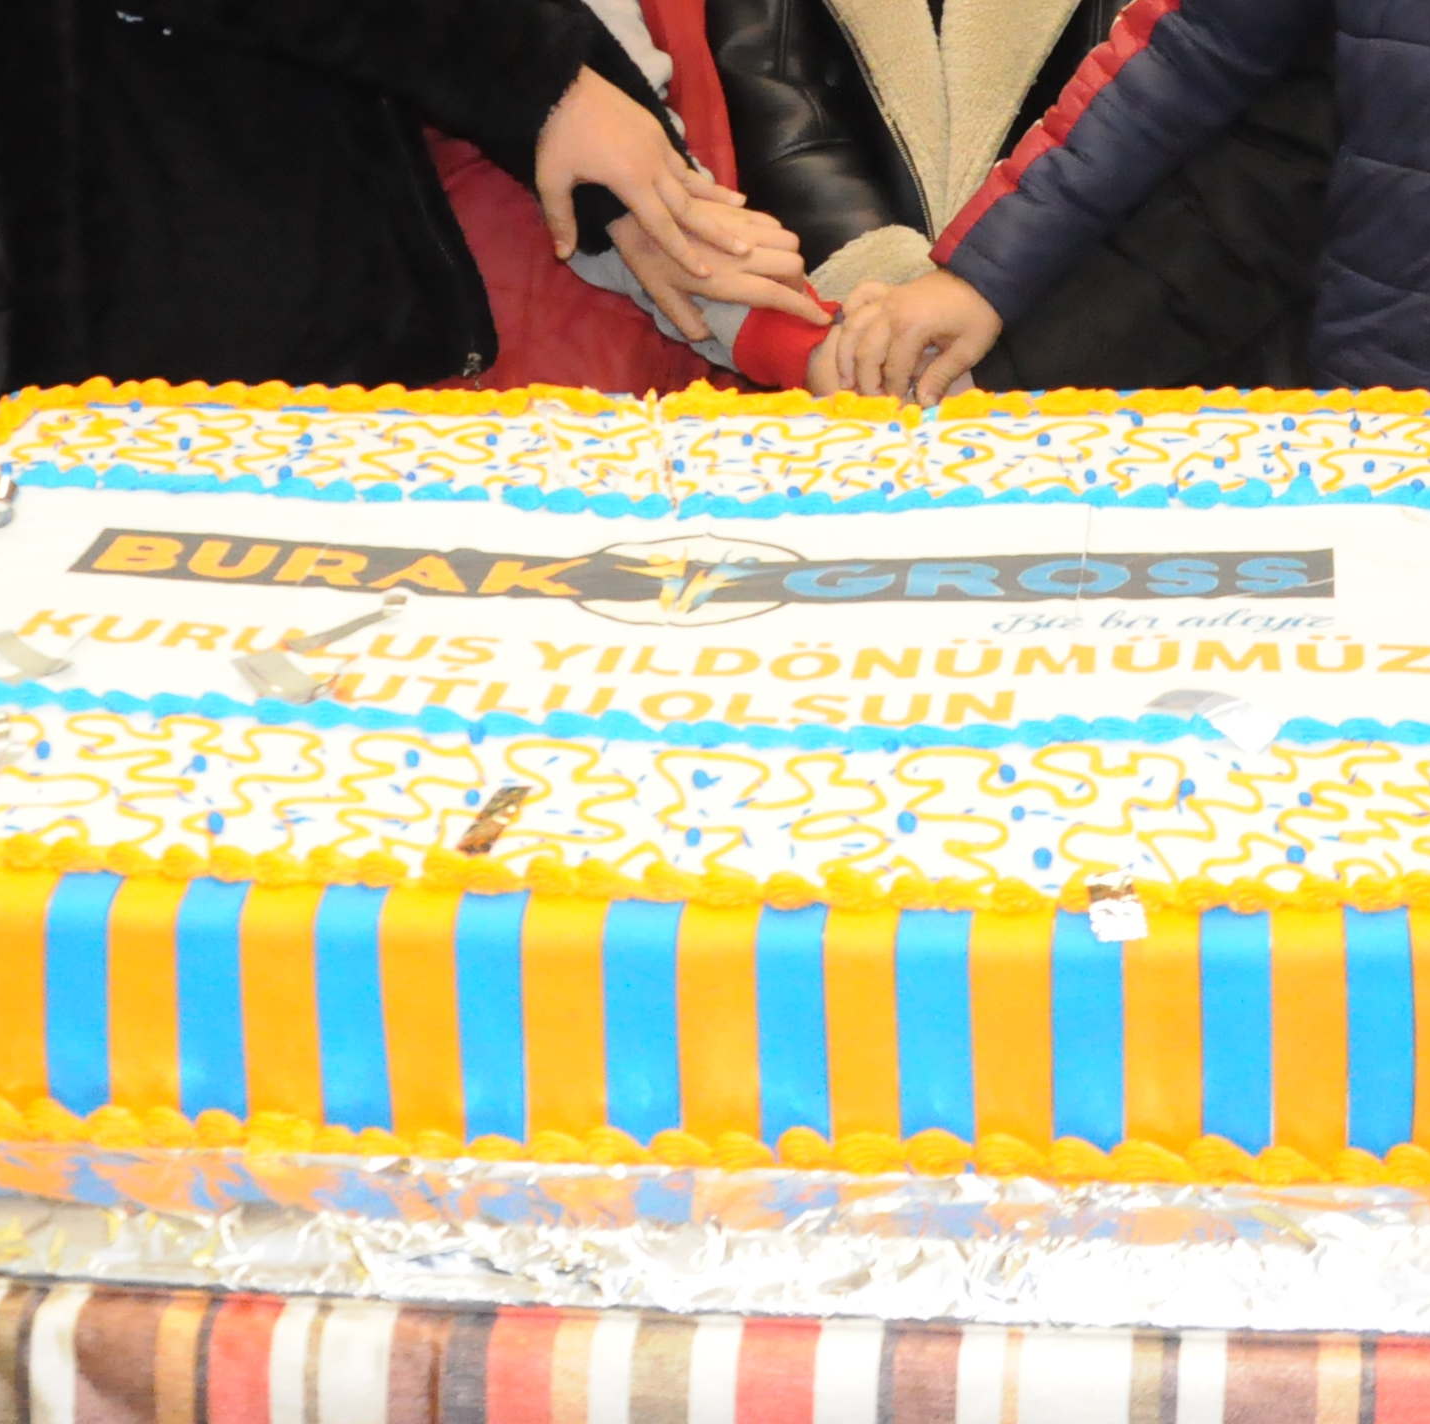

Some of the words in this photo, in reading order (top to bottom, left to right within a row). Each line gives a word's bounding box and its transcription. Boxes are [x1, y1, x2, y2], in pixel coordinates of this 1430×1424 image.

[91, 534, 590, 596] BURAK
[781, 555, 1310, 599] GROSS
[639, 689, 1017, 726] OLSUN
